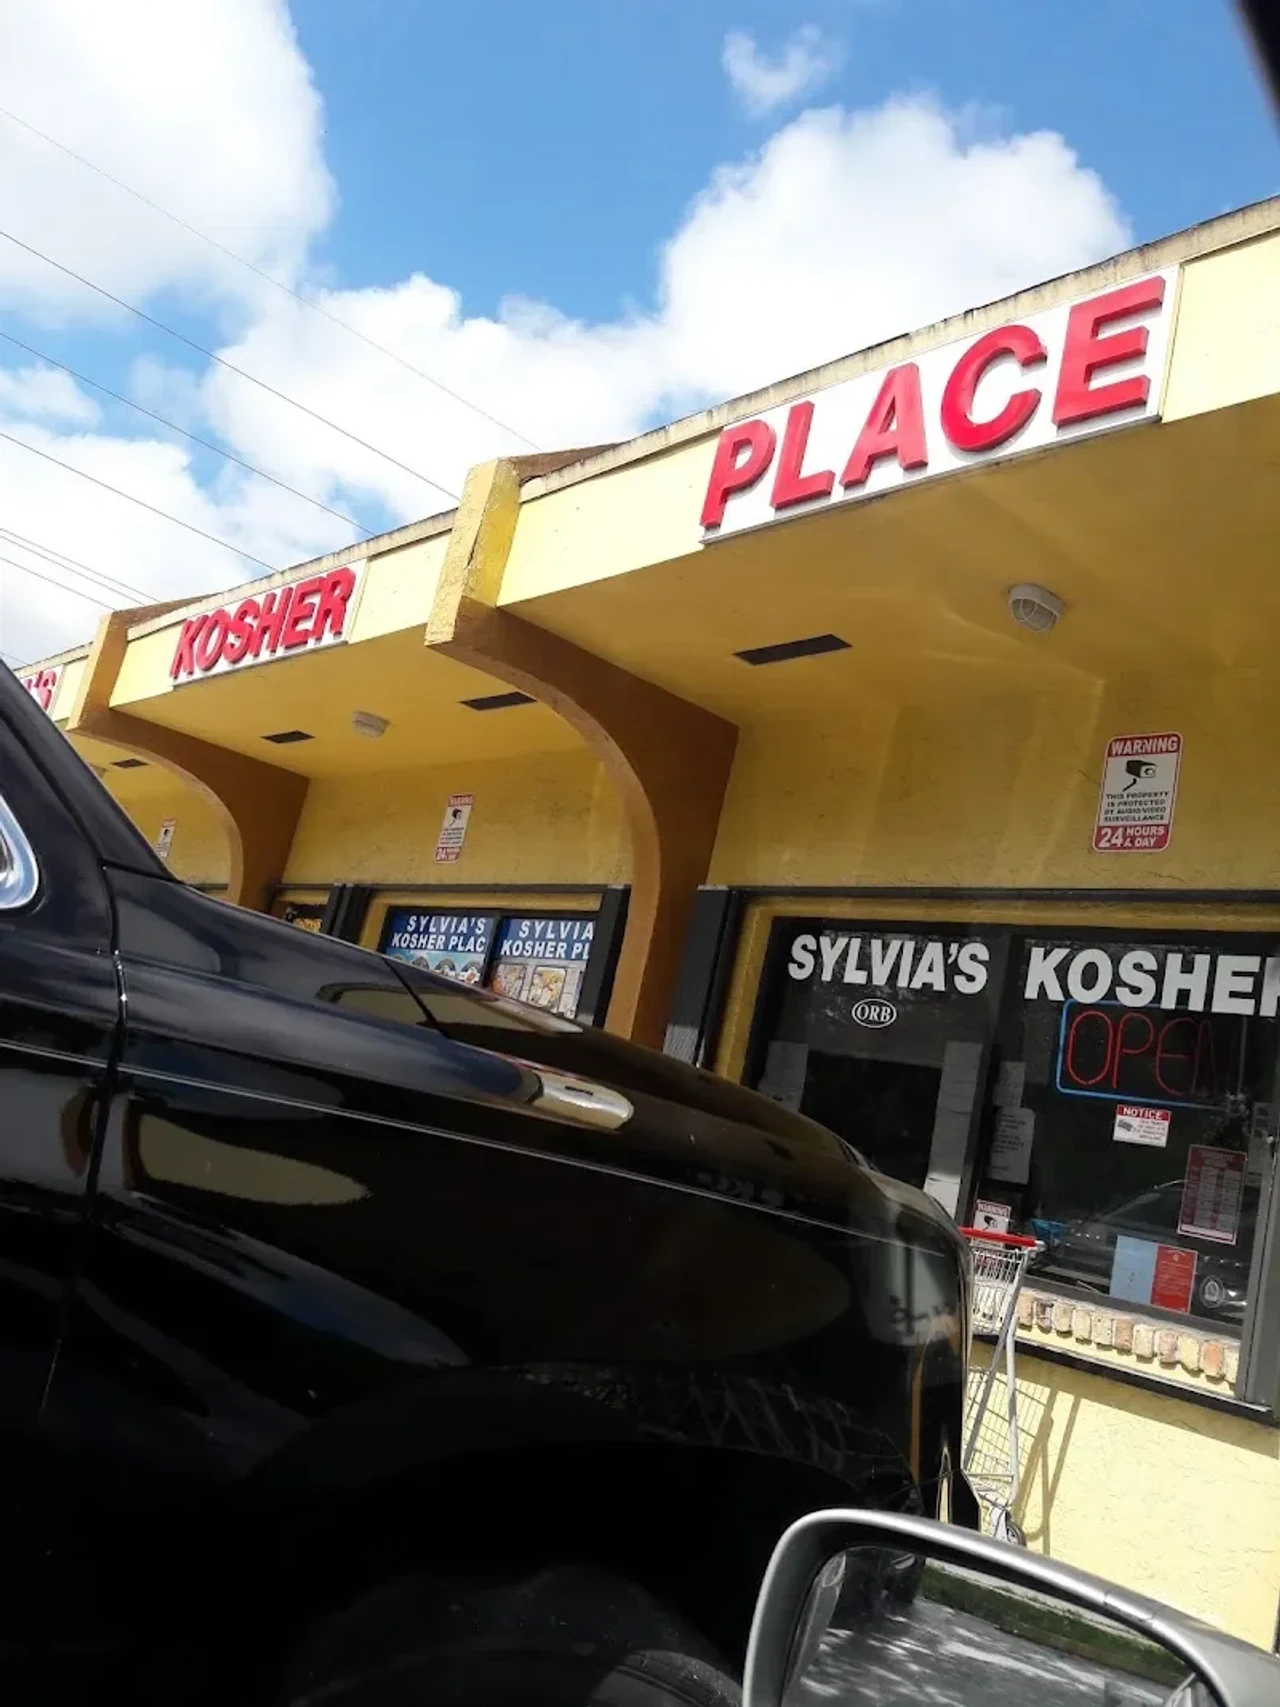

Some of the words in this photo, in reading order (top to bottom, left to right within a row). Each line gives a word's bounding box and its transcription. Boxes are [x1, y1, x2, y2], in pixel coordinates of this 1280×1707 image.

[700, 276, 1167, 529] PLACE
[169, 566, 357, 680] KOSHER
[24, 670, 57, 711] 'S
[1112, 736, 1178, 755] WARNING
[1117, 799, 1166, 807] PROTECTED
[1126, 791, 1169, 799] PROPERTY
[1104, 814, 1165, 822] SURVEILLANCE
[1098, 827, 1123, 847] 24
[1126, 826, 1165, 836] HOURS
[1124, 837, 1132, 848] A
[1134, 836, 1157, 848] DAY
[407, 915, 486, 934] SYLVIA'S
[519, 920, 594, 940] SYLVIA
[391, 932, 446, 950] KOSHER
[448, 935, 486, 952] PLAC
[501, 939, 568, 958] KOSHER
[788, 933, 990, 995] SYLVIA'S
[856, 1003, 891, 1022] ORB
[1123, 1106, 1164, 1120] NOTICE
